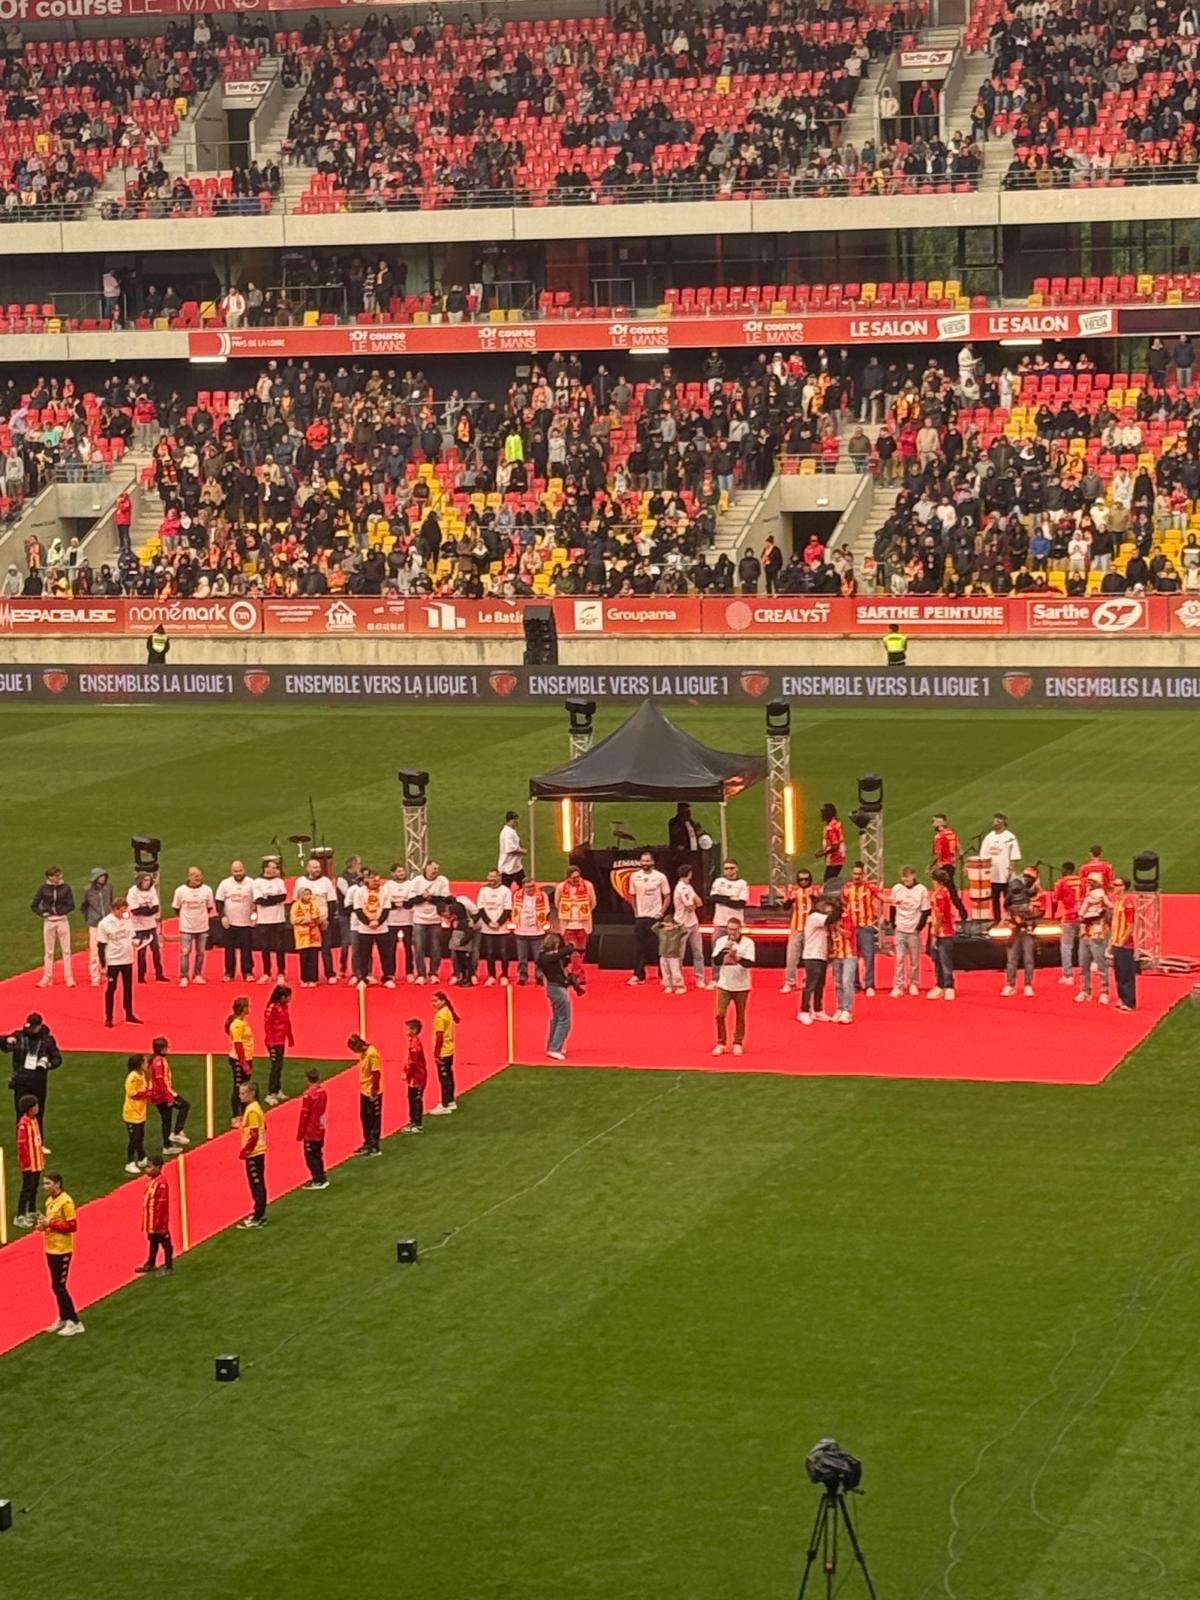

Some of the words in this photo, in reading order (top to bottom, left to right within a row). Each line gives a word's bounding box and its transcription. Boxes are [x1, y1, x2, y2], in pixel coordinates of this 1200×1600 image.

[36, 0, 122, 17] course
[629, 326, 668, 334] course
[764, 322, 803, 331] course
[871, 320, 928, 336] SALON
[1010, 315, 1068, 332] SALON
[369, 332, 406, 341] course
[498, 330, 536, 338] course
[612, 335, 628, 347] LE
[632, 335, 669, 346] MANS
[746, 332, 762, 344] LE
[766, 331, 804, 343] MANS
[352, 341, 368, 352] LE
[371, 340, 407, 351] MANS
[481, 339, 496, 350] LE
[500, 338, 536, 349] MANS
[478, 611, 493, 623] Le
[607, 608, 677, 622] Groupama
[754, 608, 831, 623] CREALYST
[857, 606, 919, 619] SARTHE
[923, 606, 1004, 619] PEINTURE
[1033, 604, 1089, 619] Sarthe
[25, 674, 32, 691] 1
[79, 674, 160, 693] ENSEMBLES
[163, 675, 180, 693] LA
[184, 675, 224, 693] LIGUE
[227, 675, 233, 693] 1
[285, 675, 360, 694] ENSEMBLE
[362, 675, 401, 694] VERS
[405, 676, 422, 694] LA
[426, 676, 468, 694] LIGUE
[471, 676, 478, 694] 1
[529, 676, 606, 695] ENSEMBLE
[609, 676, 649, 695] VERS
[653, 676, 672, 695] LA
[675, 676, 718, 695] LIGUE
[721, 677, 729, 695] 1
[782, 677, 862, 696] ENSEMBLE
[865, 677, 907, 696] VERS
[911, 678, 930, 696] LA
[934, 678, 979, 697] LIGUE
[982, 678, 990, 697] 1
[1045, 677, 1139, 698] ENSEMBLES
[1142, 678, 1162, 698] LA
